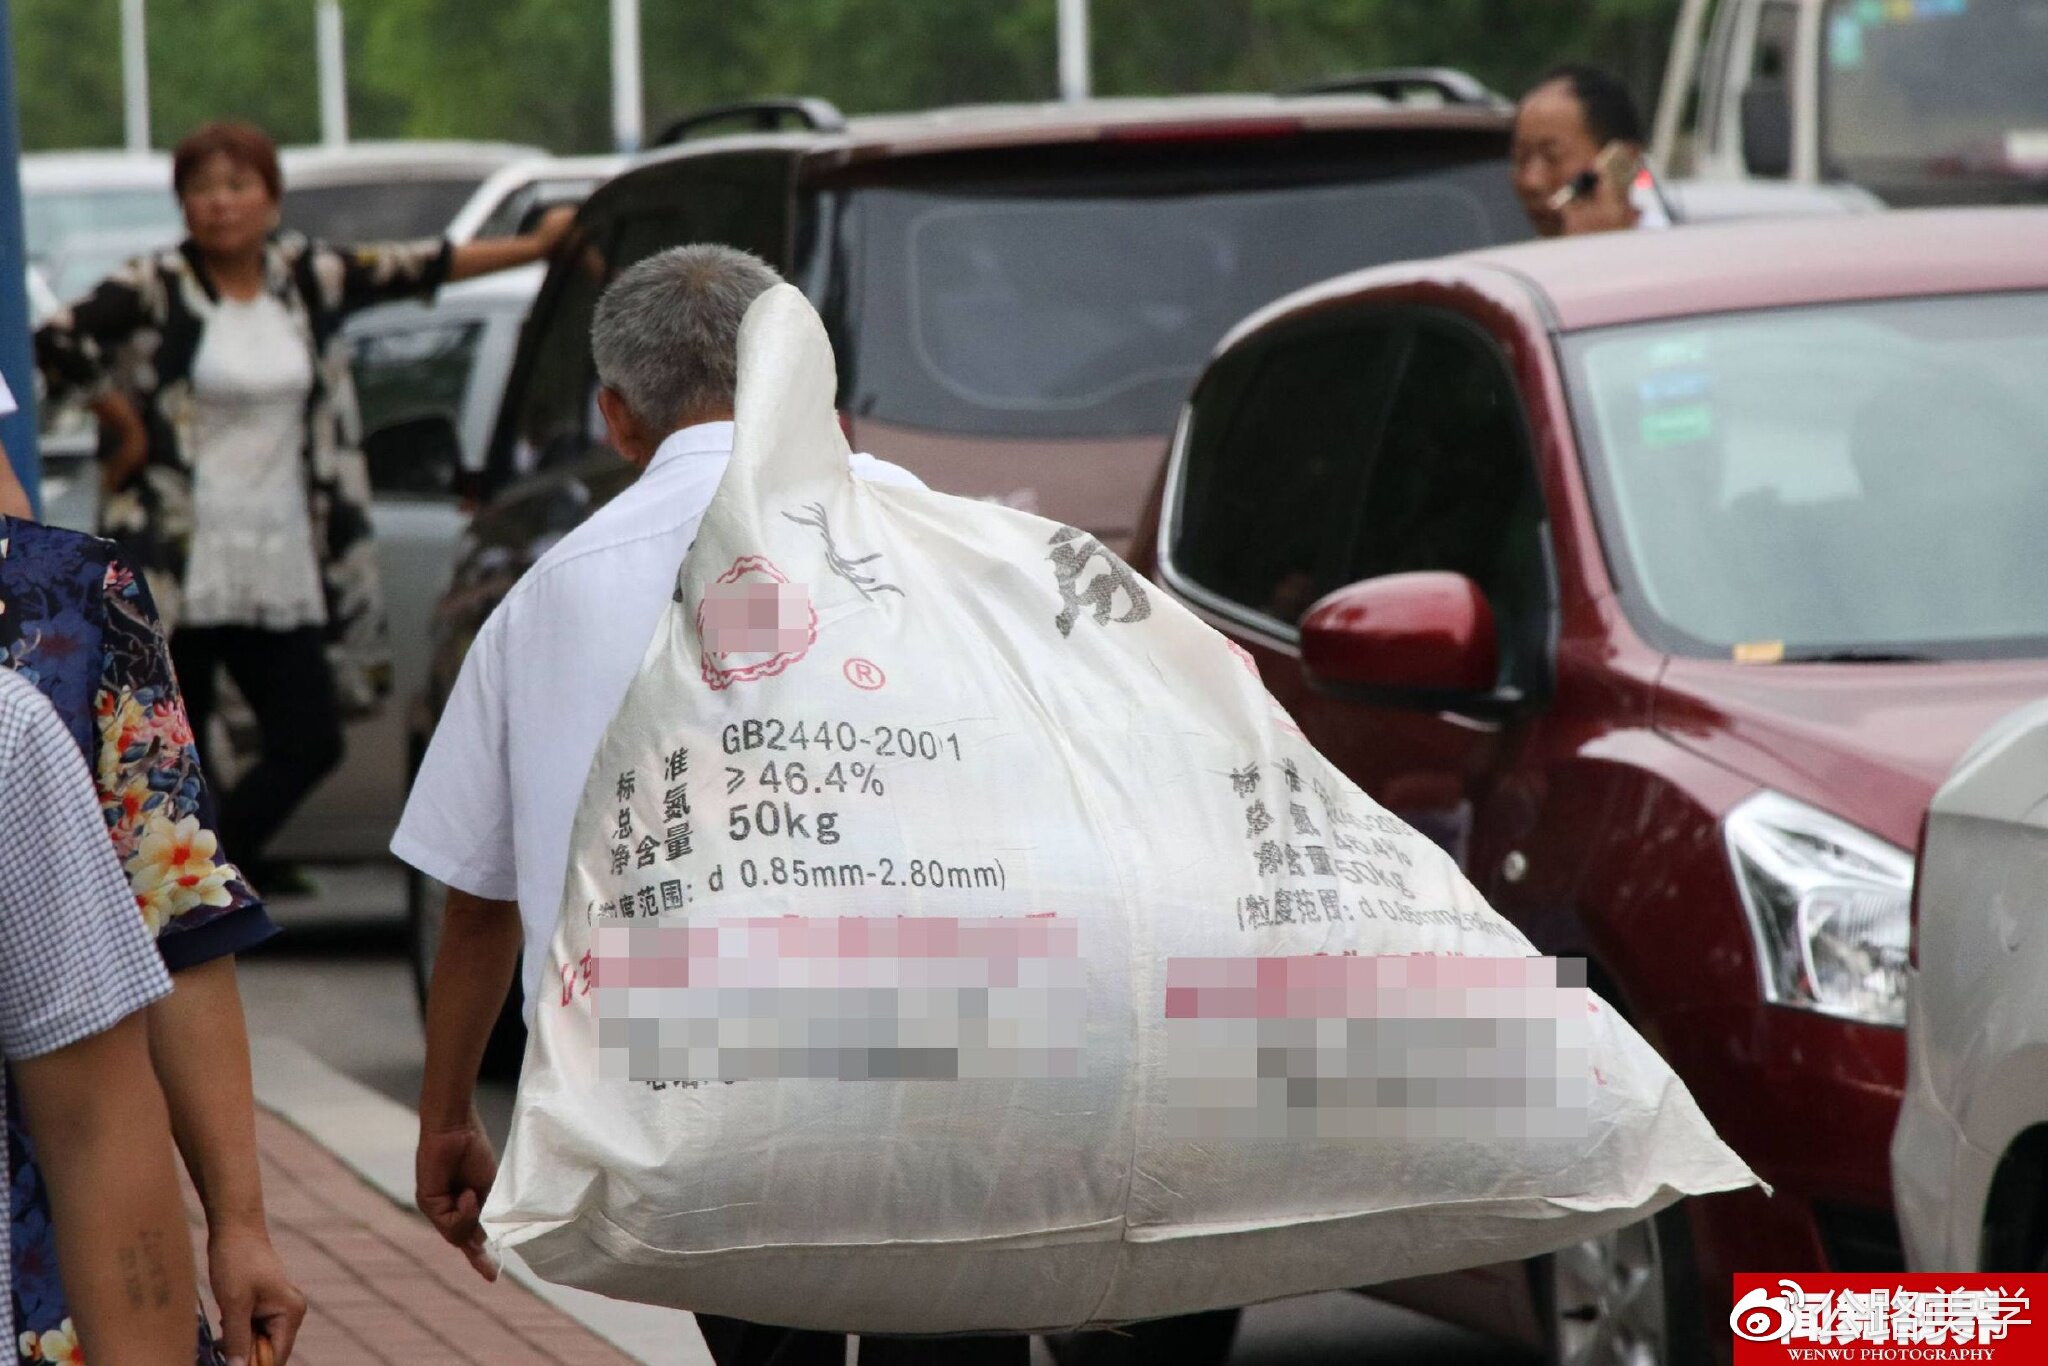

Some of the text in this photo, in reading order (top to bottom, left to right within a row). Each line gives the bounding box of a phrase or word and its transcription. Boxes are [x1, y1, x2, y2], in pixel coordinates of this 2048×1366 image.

[722, 718, 961, 762] GB2440-2001
[728, 800, 841, 845] 50kg
[708, 864, 723, 893] d
[740, 857, 1006, 892] 0.85mm-2.80mm)
[1334, 859, 1416, 900] 50kg
